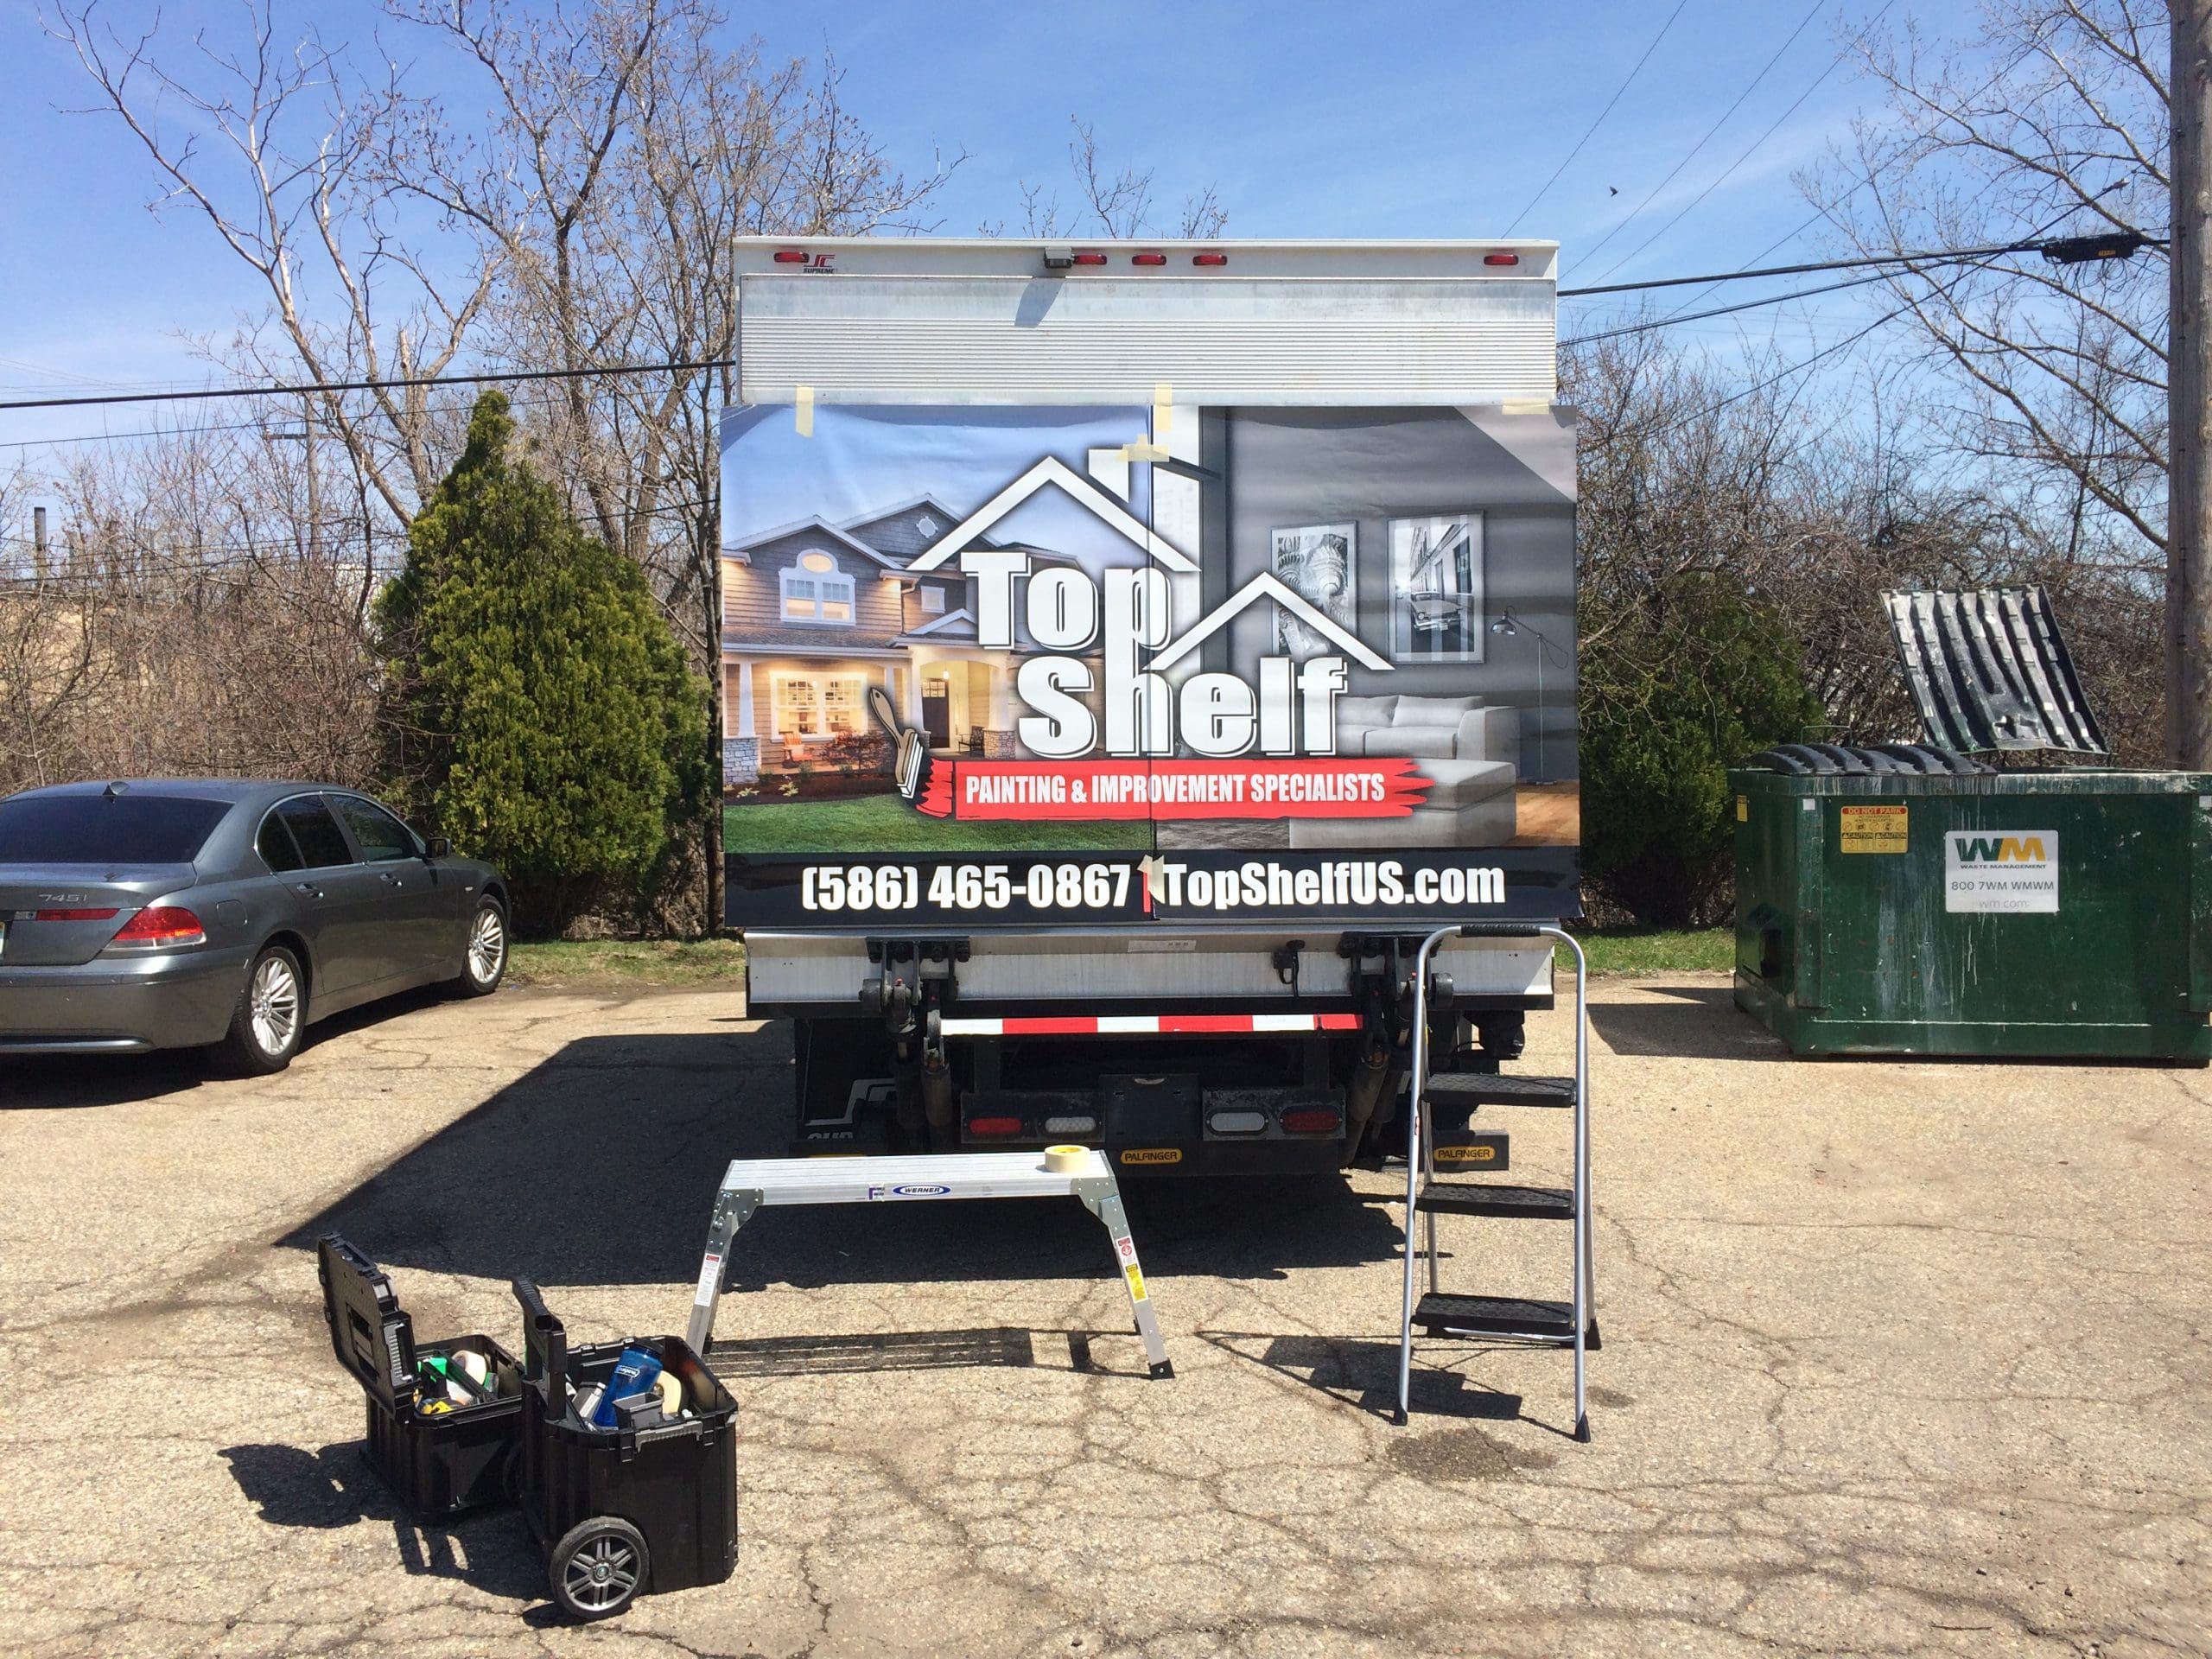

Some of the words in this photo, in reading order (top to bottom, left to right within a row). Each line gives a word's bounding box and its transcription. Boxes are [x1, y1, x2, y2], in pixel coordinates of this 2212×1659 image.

[960, 552, 1172, 655] Top
[1017, 655, 1349, 760] Shelf
[965, 774, 1066, 804] PAINTING
[1071, 779, 1088, 804] &
[1091, 773, 1246, 804] IMPROVEMENT
[1250, 773, 1385, 803] SPECIALISTS
[1955, 837, 2047, 861] WM
[802, 865, 919, 910] (586)
[927, 864, 1131, 909] 465-0867
[1162, 861, 1506, 911] TopShelfUS.com
[1951, 880, 1975, 891] 800
[1979, 880, 2008, 891] 7WM
[2011, 880, 2055, 891] WMWM
[1124, 1151, 1178, 1162] PALFINGER
[1438, 1149, 1490, 1158] PALFINGER
